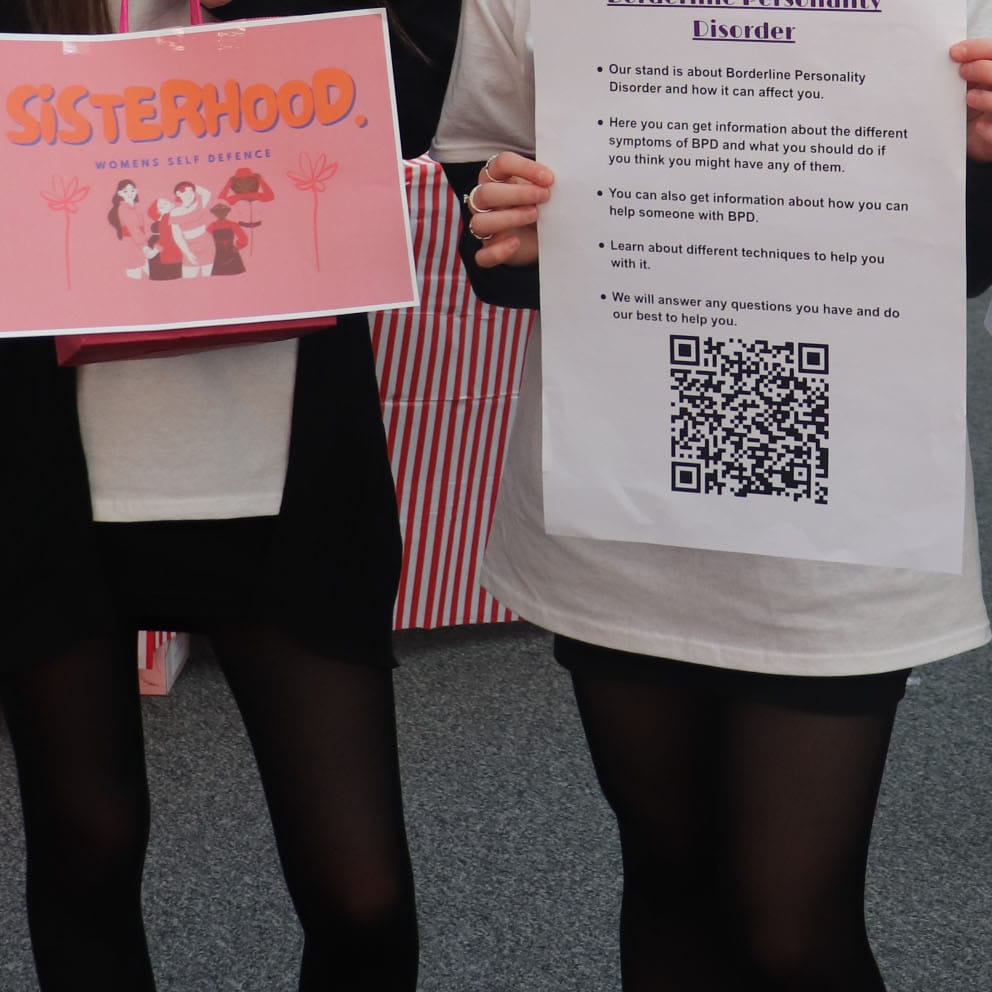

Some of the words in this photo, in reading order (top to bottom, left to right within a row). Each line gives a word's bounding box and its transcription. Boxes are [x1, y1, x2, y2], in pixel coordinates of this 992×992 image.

[692, 19, 796, 41] Disorder
[609, 64, 631, 74] Our
[636, 65, 668, 75] stand
[673, 65, 682, 76] is
[688, 66, 722, 77] about
[727, 68, 790, 80] Borderline
[796, 70, 865, 85] Personality
[610, 82, 661, 93] Disorder
[666, 83, 687, 94] and
[692, 84, 717, 95] how
[722, 85, 729, 96] it
[733, 88, 754, 96] can
[759, 87, 793, 98] affect
[798, 90, 823, 101] you.
[610, 117, 636, 128] Here
[641, 121, 662, 131] you
[668, 122, 688, 130] can
[693, 122, 711, 133] get
[716, 122, 786, 134] information
[792, 124, 826, 135] about
[831, 126, 850, 136] the
[855, 127, 907, 138] different
[609, 137, 672, 149] symptoms
[676, 138, 688, 148] of
[692, 138, 718, 149] BPD
[723, 140, 744, 150] and
[750, 141, 778, 152] what
[783, 144, 805, 154] you
[810, 143, 853, 154] should
[858, 145, 873, 155] do
[878, 145, 886, 156] if
[95, 158, 160, 170] WOMENS
[167, 155, 200, 166] SELF
[207, 149, 272, 163] DEFENCE
[609, 155, 630, 166] you
[635, 154, 664, 164] think
[669, 158, 690, 168] you
[696, 157, 730, 170] might
[735, 158, 763, 169] have
[768, 161, 789, 172] any
[794, 160, 806, 171] of
[810, 162, 844, 172] them.
[609, 188, 631, 199] You
[636, 192, 656, 200] can
[661, 190, 686, 202] also
[690, 193, 708, 204] get
[713, 193, 784, 205] information
[789, 196, 824, 207] about
[828, 198, 854, 208] how
[859, 201, 881, 212] you
[886, 203, 908, 211] can
[610, 206, 635, 219] help
[639, 210, 694, 219] someone
[699, 210, 723, 220] with
[728, 211, 758, 222] BPD.
[611, 240, 644, 251] Learn
[648, 243, 682, 254] about
[687, 245, 738, 257] different
[742, 248, 810, 261] techniques
[814, 251, 826, 261] to
[831, 252, 857, 264] help
[862, 255, 884, 266] you
[611, 258, 635, 268] with
[640, 259, 651, 269] it.
[612, 292, 630, 302] We
[634, 293, 654, 304] will
[658, 296, 701, 306] answer
[706, 299, 726, 310] any
[732, 300, 792, 312] questions
[796, 304, 818, 315] you
[824, 304, 852, 315] have
[857, 306, 879, 316] and
[884, 307, 899, 318] do
[613, 311, 632, 320] our
[637, 310, 662, 321] best
[666, 312, 677, 322] to
[682, 313, 707, 326] help
[712, 317, 737, 327] you.
